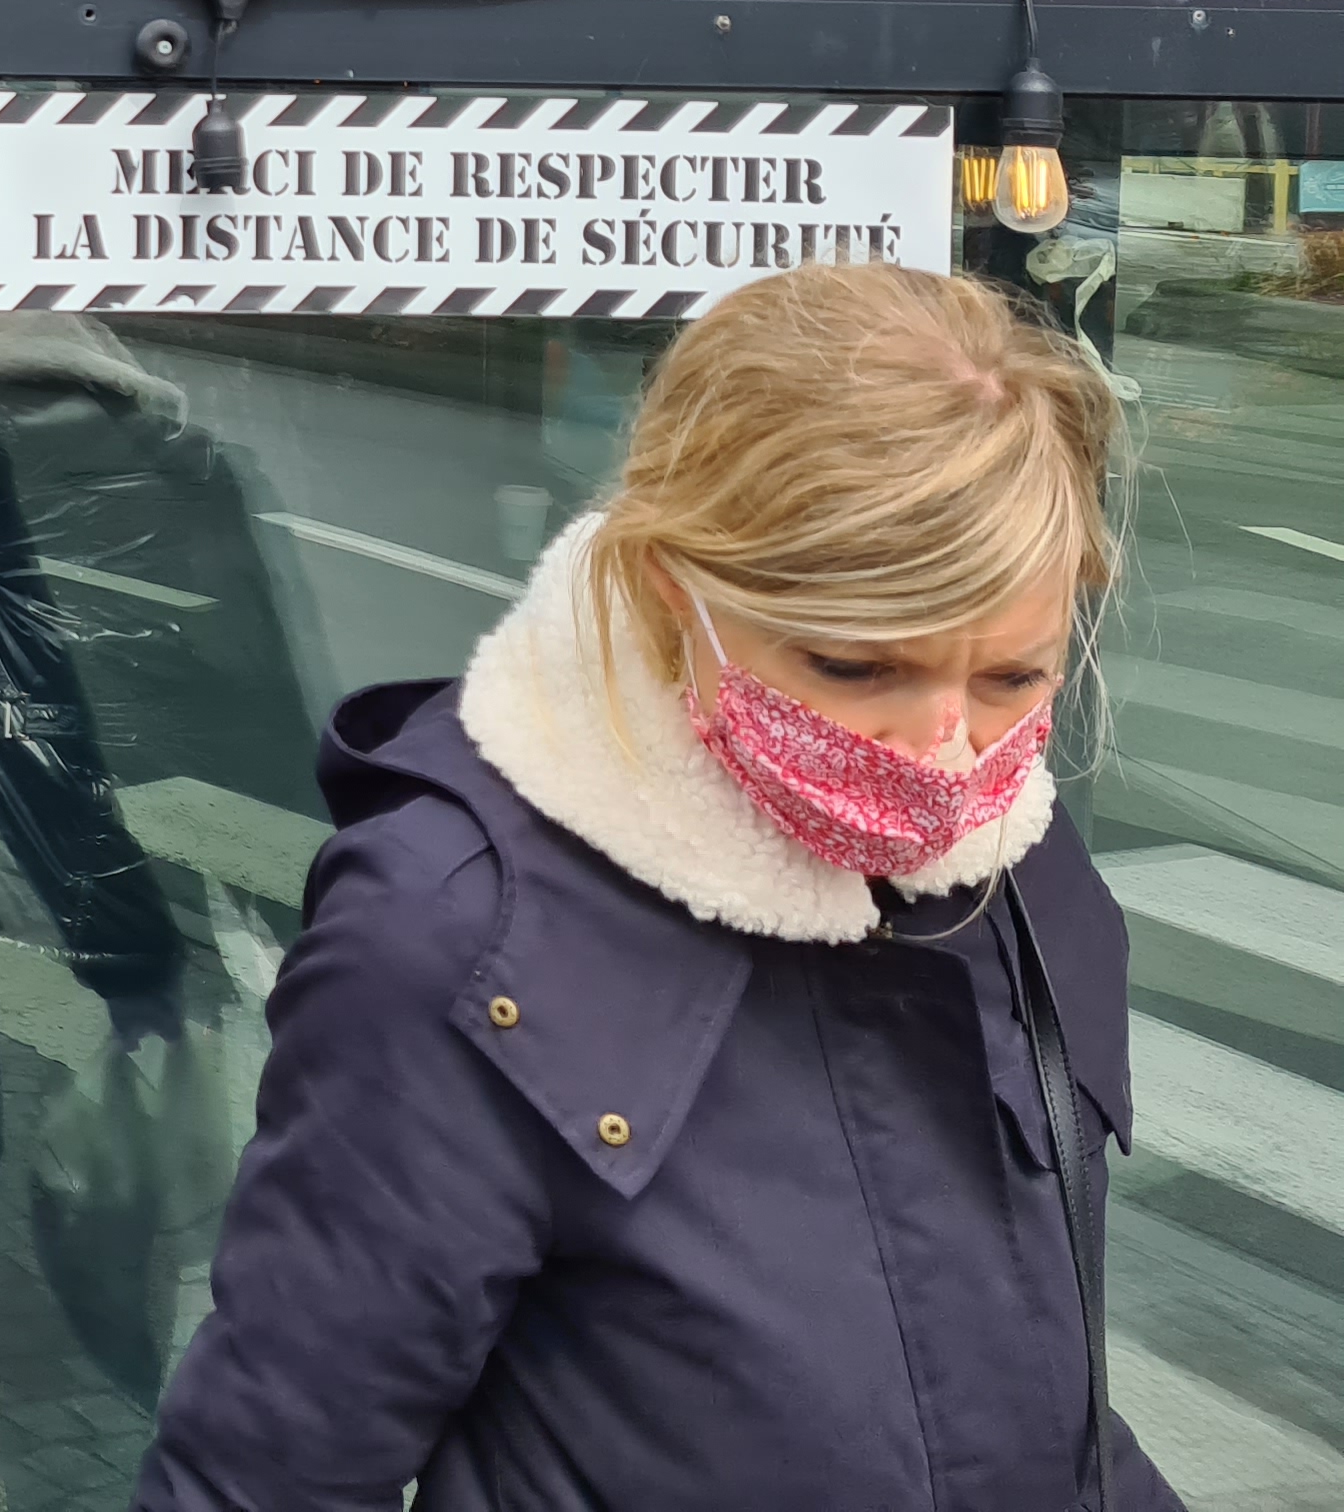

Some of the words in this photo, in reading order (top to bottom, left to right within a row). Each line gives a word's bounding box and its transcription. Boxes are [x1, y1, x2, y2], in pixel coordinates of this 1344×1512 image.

[110, 148, 318, 196] MECI
[342, 150, 424, 197] DE
[449, 151, 827, 205] RESPECTER
[32, 213, 110, 261] LA
[133, 214, 451, 264] DISTANCE
[475, 216, 558, 265] DE
[581, 208, 902, 269] SÉCURITÉ
